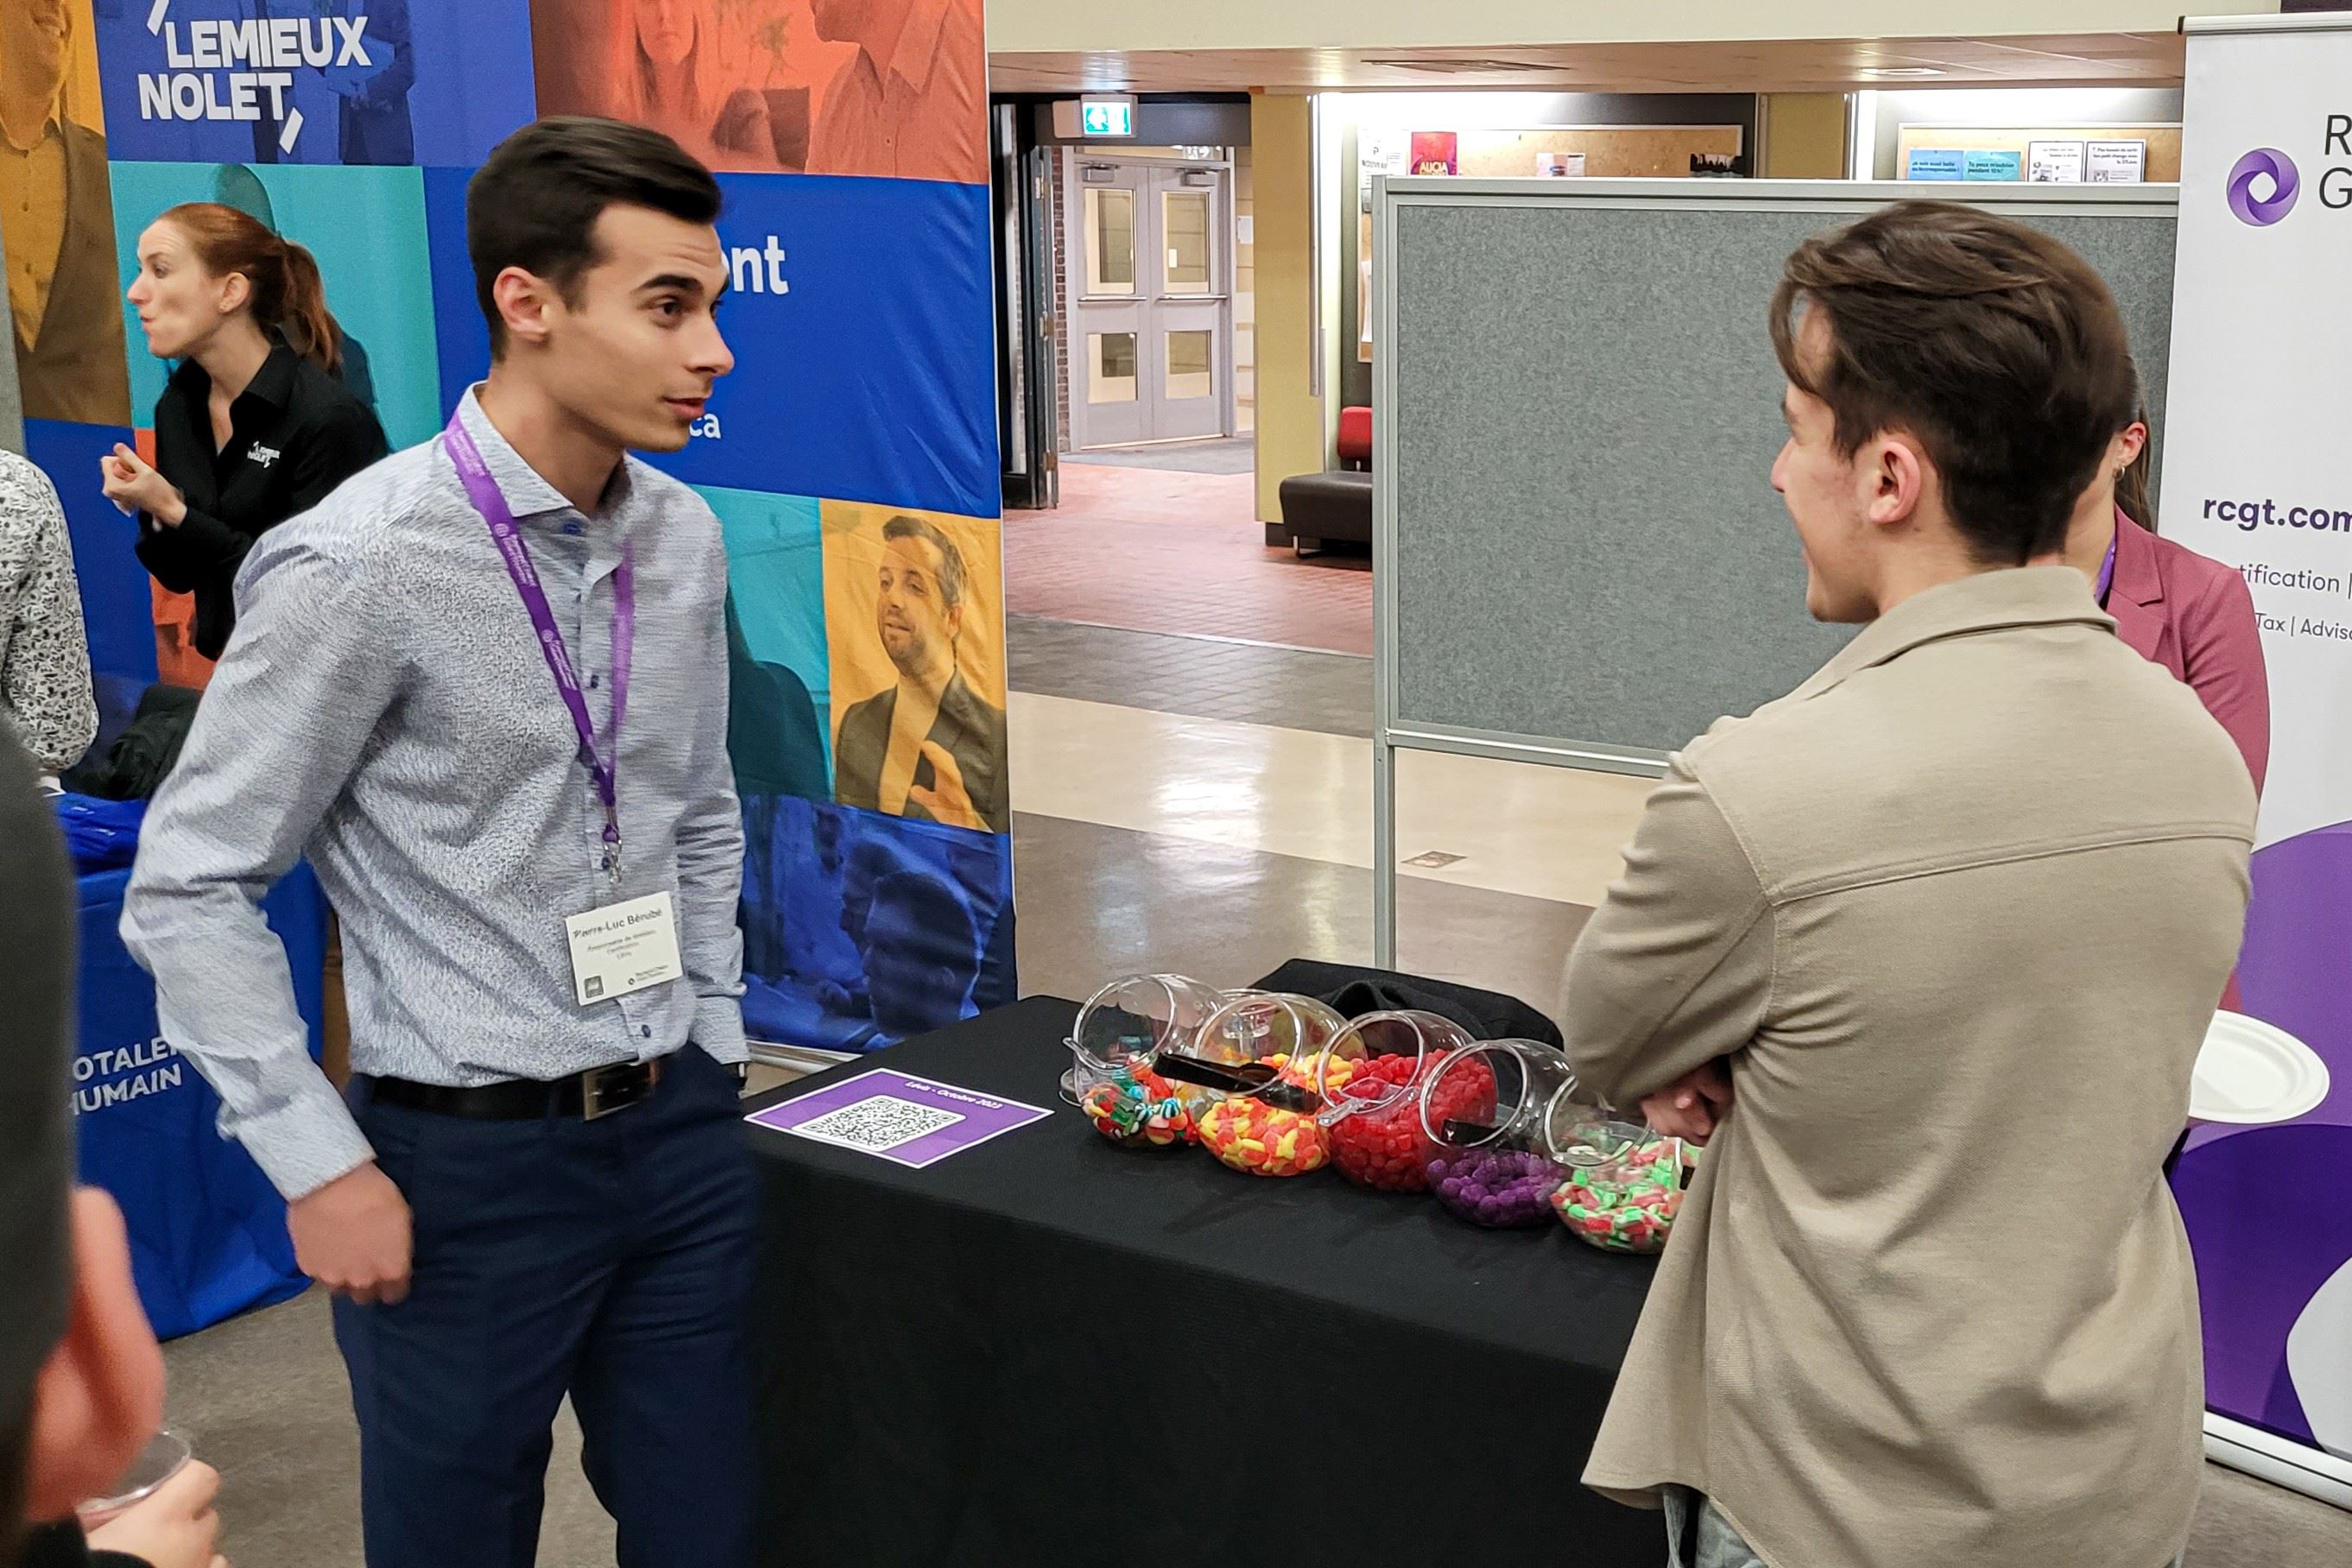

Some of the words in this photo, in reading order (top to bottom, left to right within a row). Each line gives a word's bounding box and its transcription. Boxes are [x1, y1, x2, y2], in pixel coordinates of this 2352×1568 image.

[165, 16, 372, 69] LEMIEUX
[138, 72, 293, 121] NOLET
[722, 235, 789, 295] nt
[2203, 498, 2352, 532] rcgt.com
